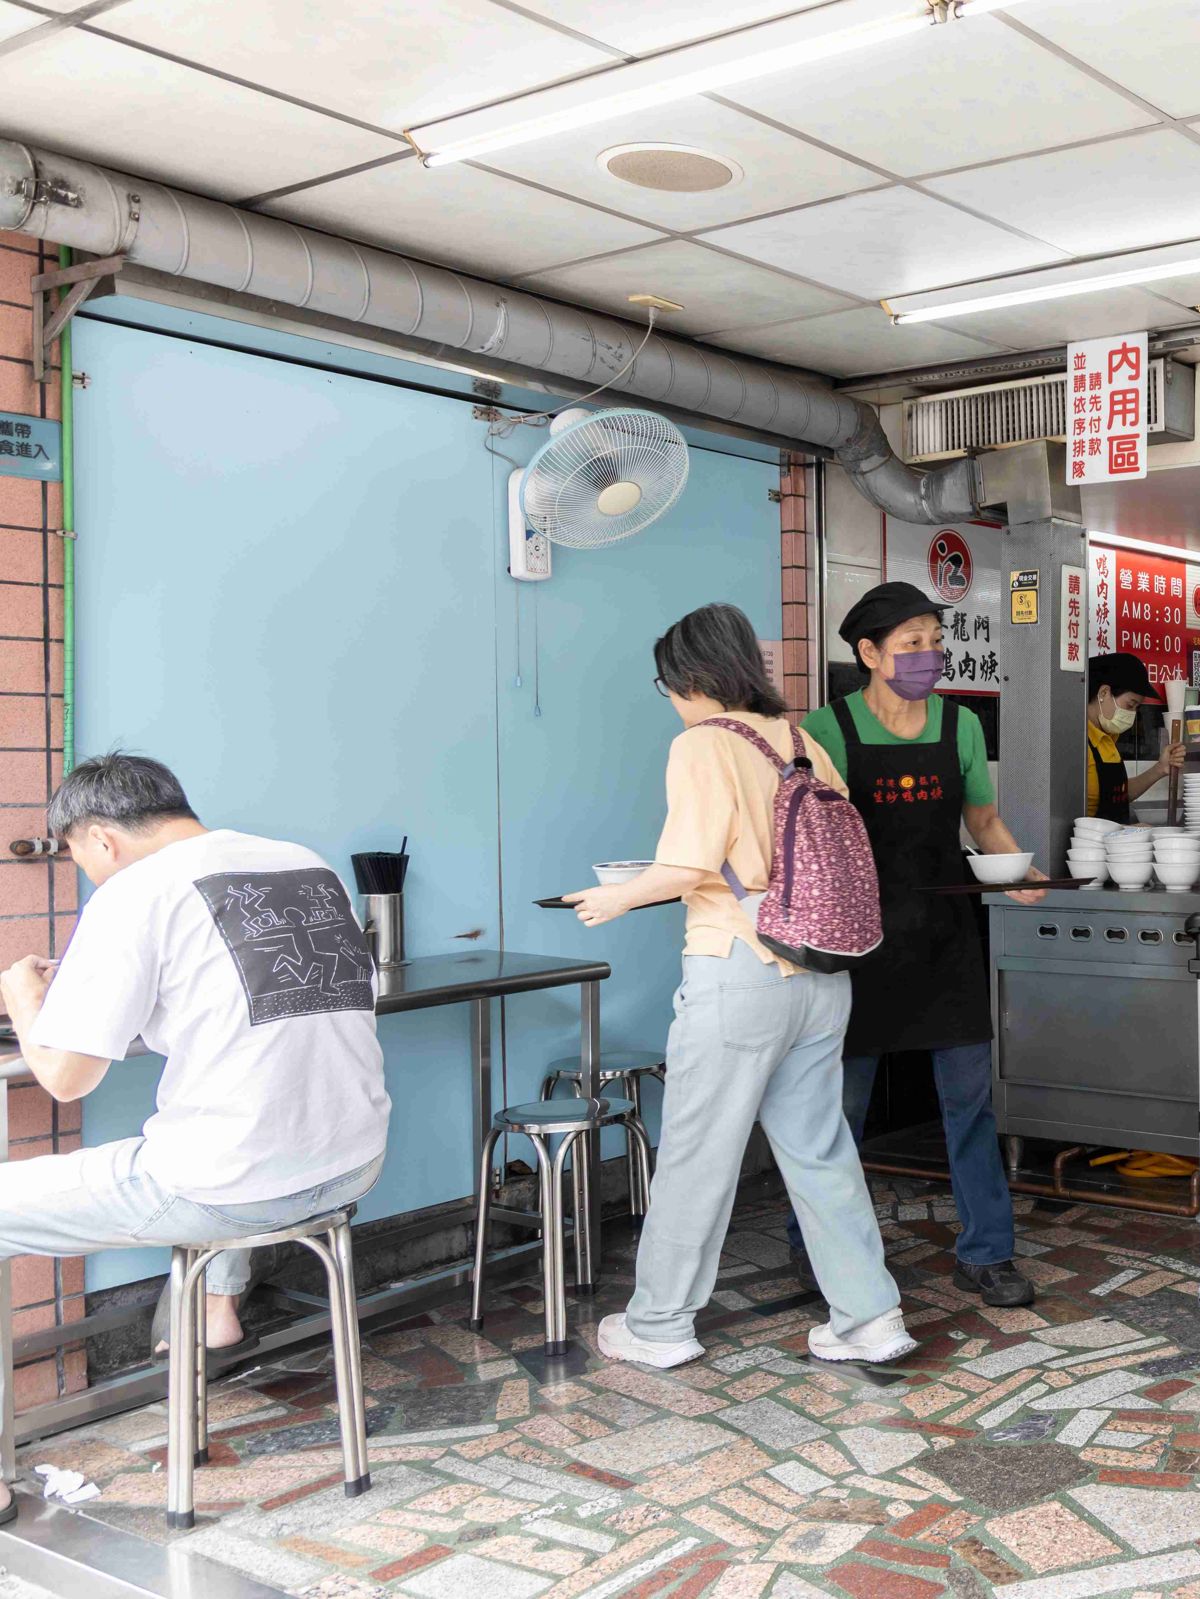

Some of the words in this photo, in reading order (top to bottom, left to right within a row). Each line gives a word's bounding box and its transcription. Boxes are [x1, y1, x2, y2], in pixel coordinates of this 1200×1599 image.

[1072, 352, 1087, 479] 並請依序排隊
[1088, 371, 1102, 456] 請先付款
[1107, 342, 1140, 474] 內用區
[1096, 554, 1111, 657] 鴨肉焿粄
[1119, 568, 1183, 598] 營業時間
[1121, 600, 1181, 625] AM8:30
[942, 609, 990, 643] 龍門
[1067, 575, 1081, 662] 請先付款
[1121, 630, 1181, 653] PM6:00
[1143, 663, 1184, 683] 日公休
